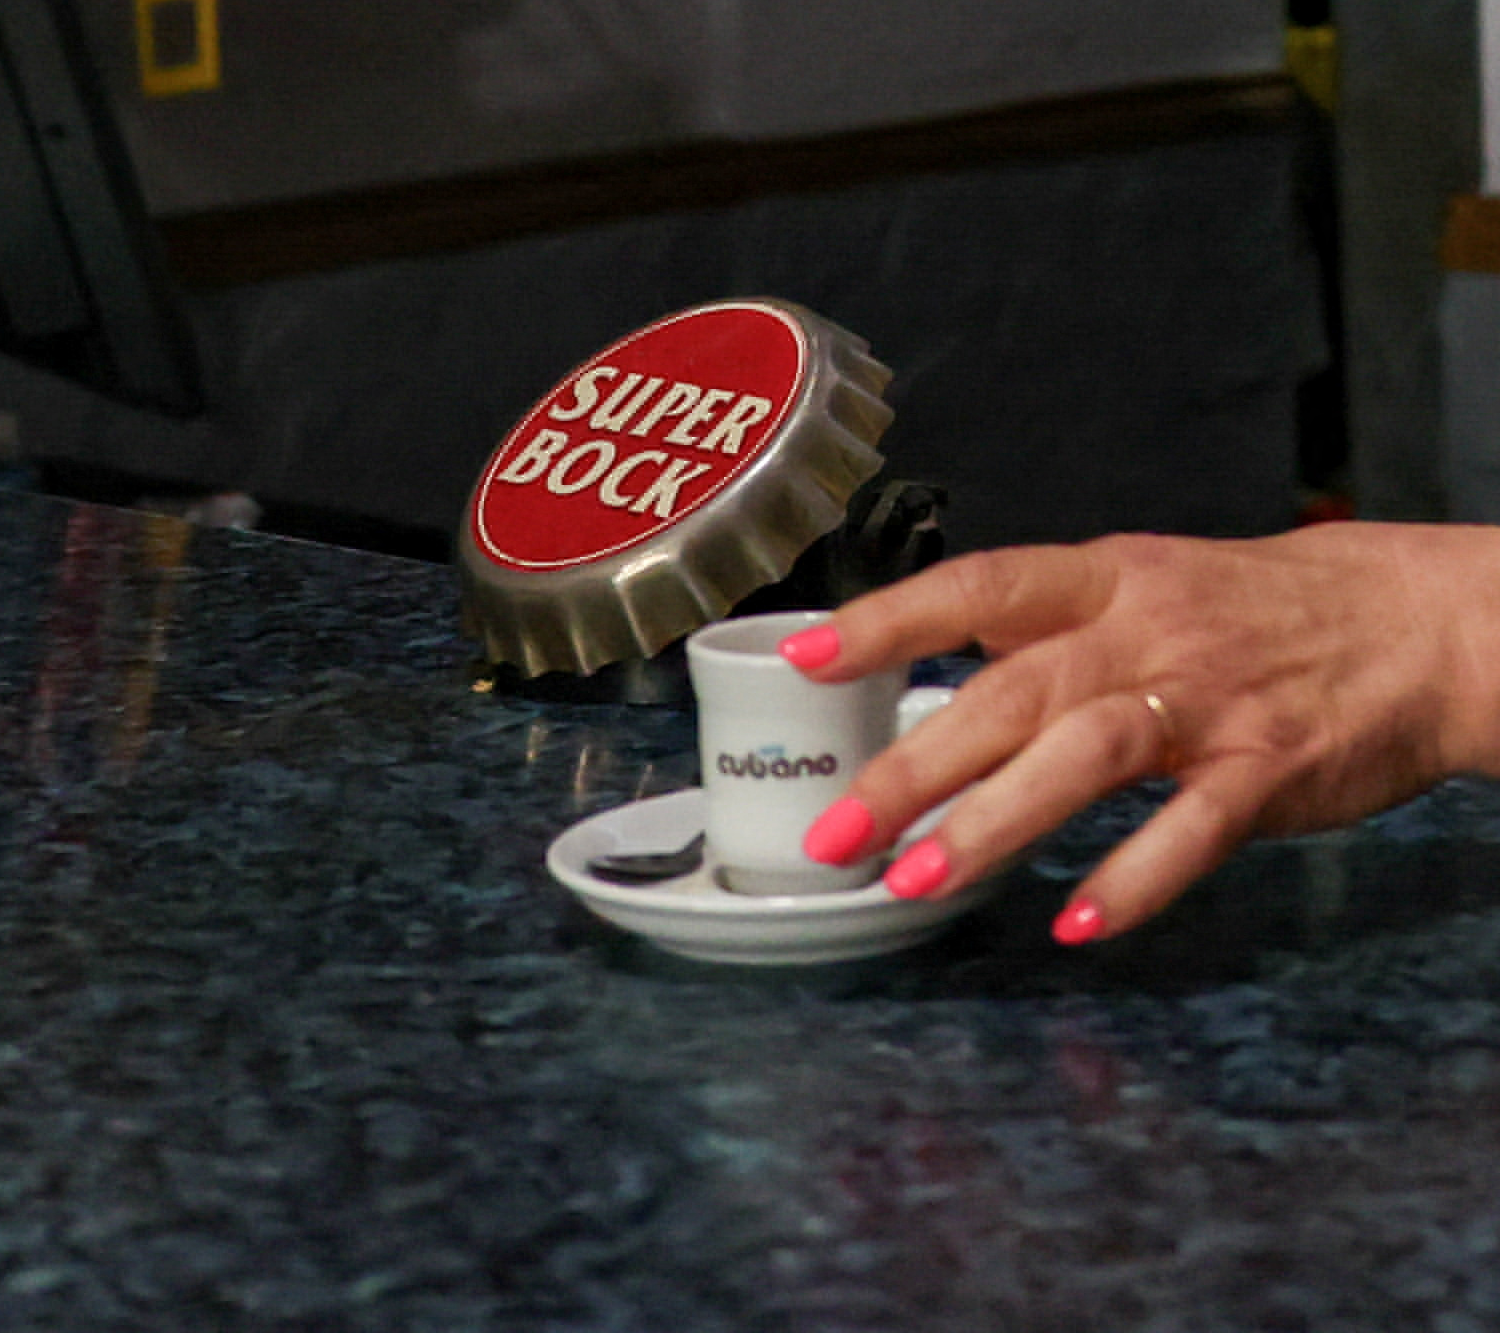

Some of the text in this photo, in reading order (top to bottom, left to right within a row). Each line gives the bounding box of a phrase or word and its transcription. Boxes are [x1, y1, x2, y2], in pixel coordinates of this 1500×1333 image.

[548, 366, 773, 457] SUPER
[498, 428, 713, 520] BOCK
[716, 750, 838, 780] cubano
